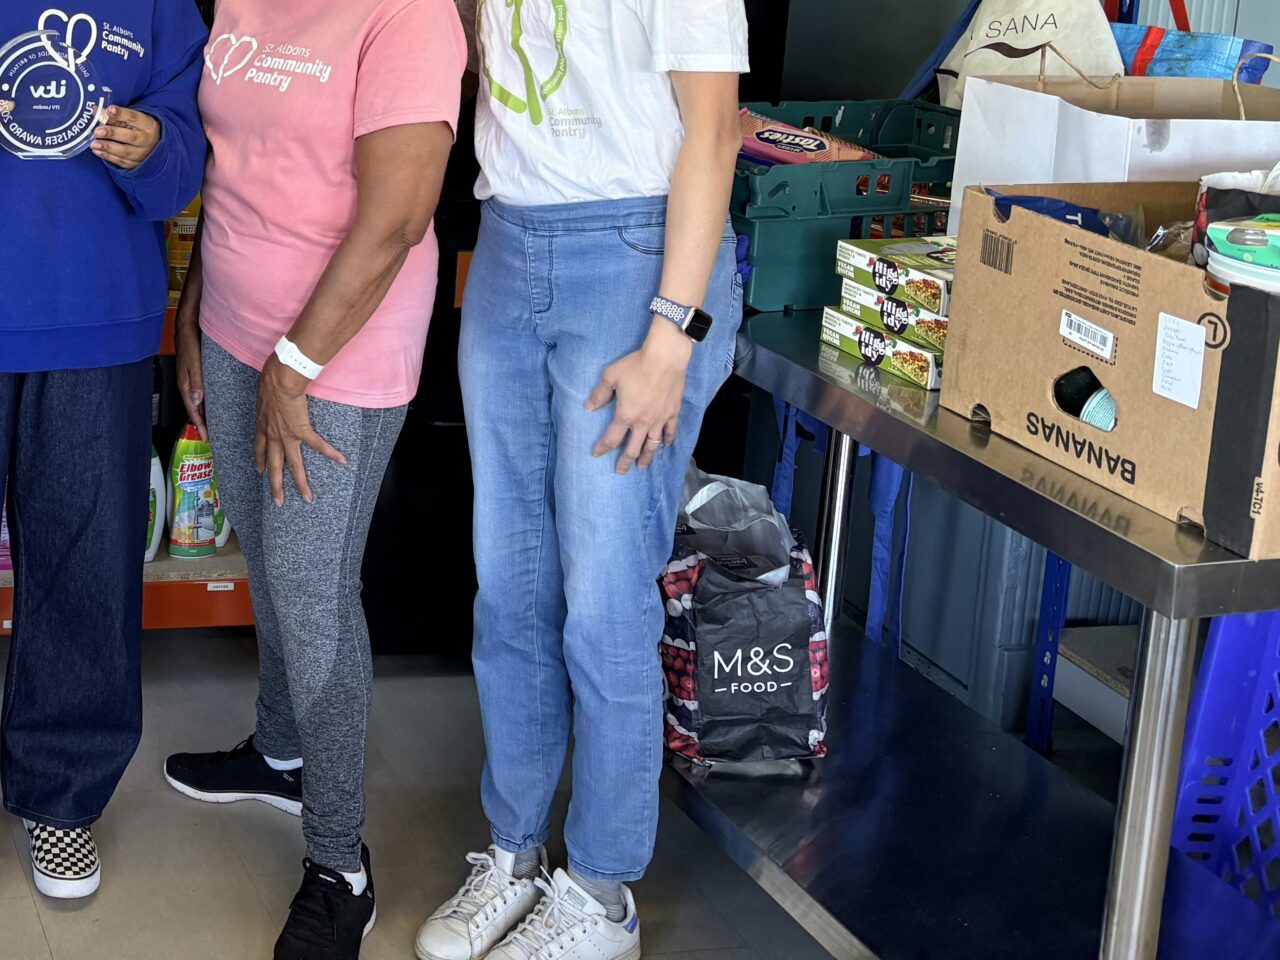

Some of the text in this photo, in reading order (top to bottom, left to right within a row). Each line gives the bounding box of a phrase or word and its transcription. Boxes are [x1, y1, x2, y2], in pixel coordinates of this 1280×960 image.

[113, 25, 133, 38] Albans
[986, 13, 1058, 38] SANA
[101, 40, 129, 60] Pantry
[102, 30, 145, 58] Community
[276, 44, 311, 58] Albans
[254, 54, 332, 83] Community
[245, 68, 292, 92] Pantry
[558, 107, 585, 116] Albans
[550, 116, 602, 128] Community
[551, 127, 586, 138] Pantry
[760, 131, 821, 150] Tasties
[837, 262, 854, 272] VEGAN
[843, 299, 860, 310] VEGAN
[822, 327, 840, 340] VEGAN
[1027, 412, 1136, 485] BANANAS
[180, 461, 213, 473] Elbow
[180, 469, 213, 482] Grease
[1252, 482, 1265, 515] V4-TC1
[713, 642, 794, 679] M&S
[731, 681, 777, 693] FOOD
